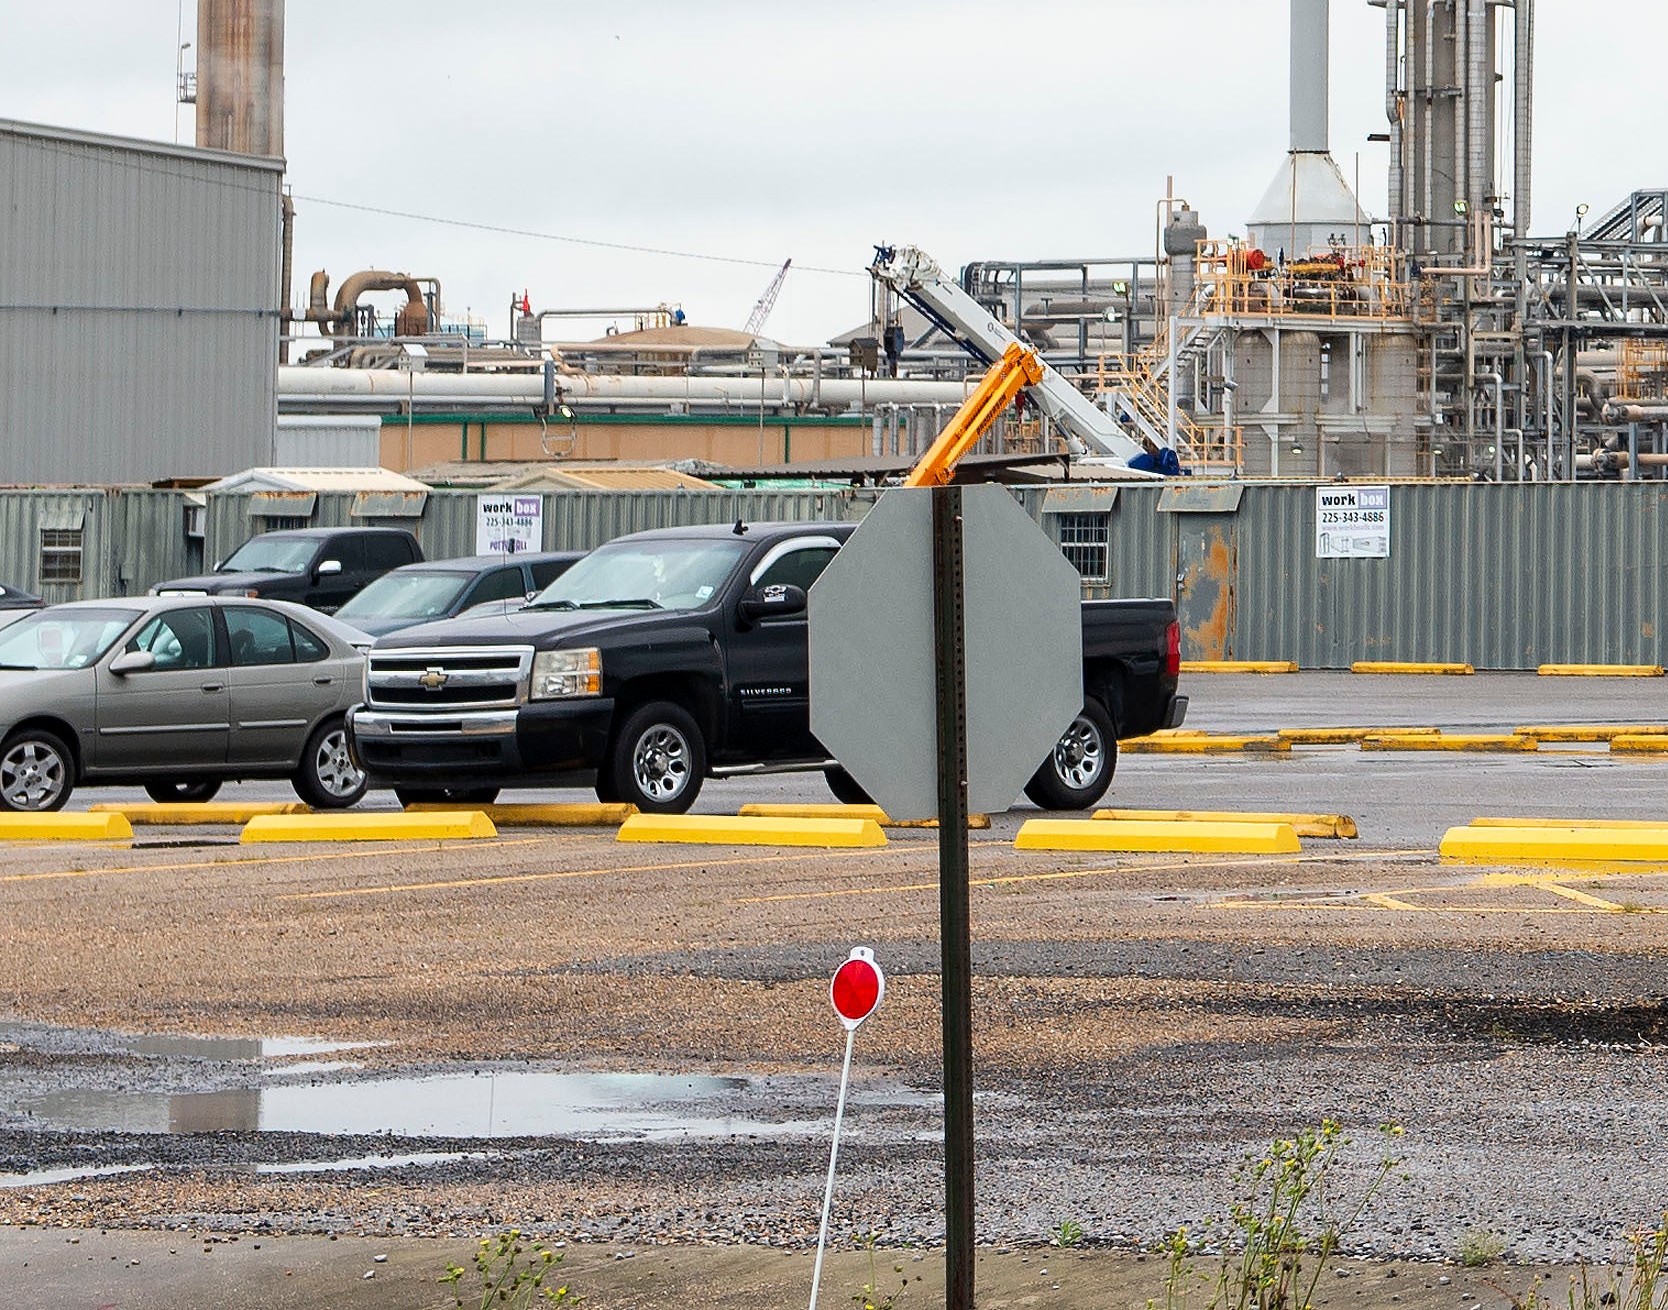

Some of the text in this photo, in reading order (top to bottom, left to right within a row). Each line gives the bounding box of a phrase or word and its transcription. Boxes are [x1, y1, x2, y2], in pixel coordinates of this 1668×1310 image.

[1322, 492, 1385, 506] work box
[483, 501, 537, 515] work box
